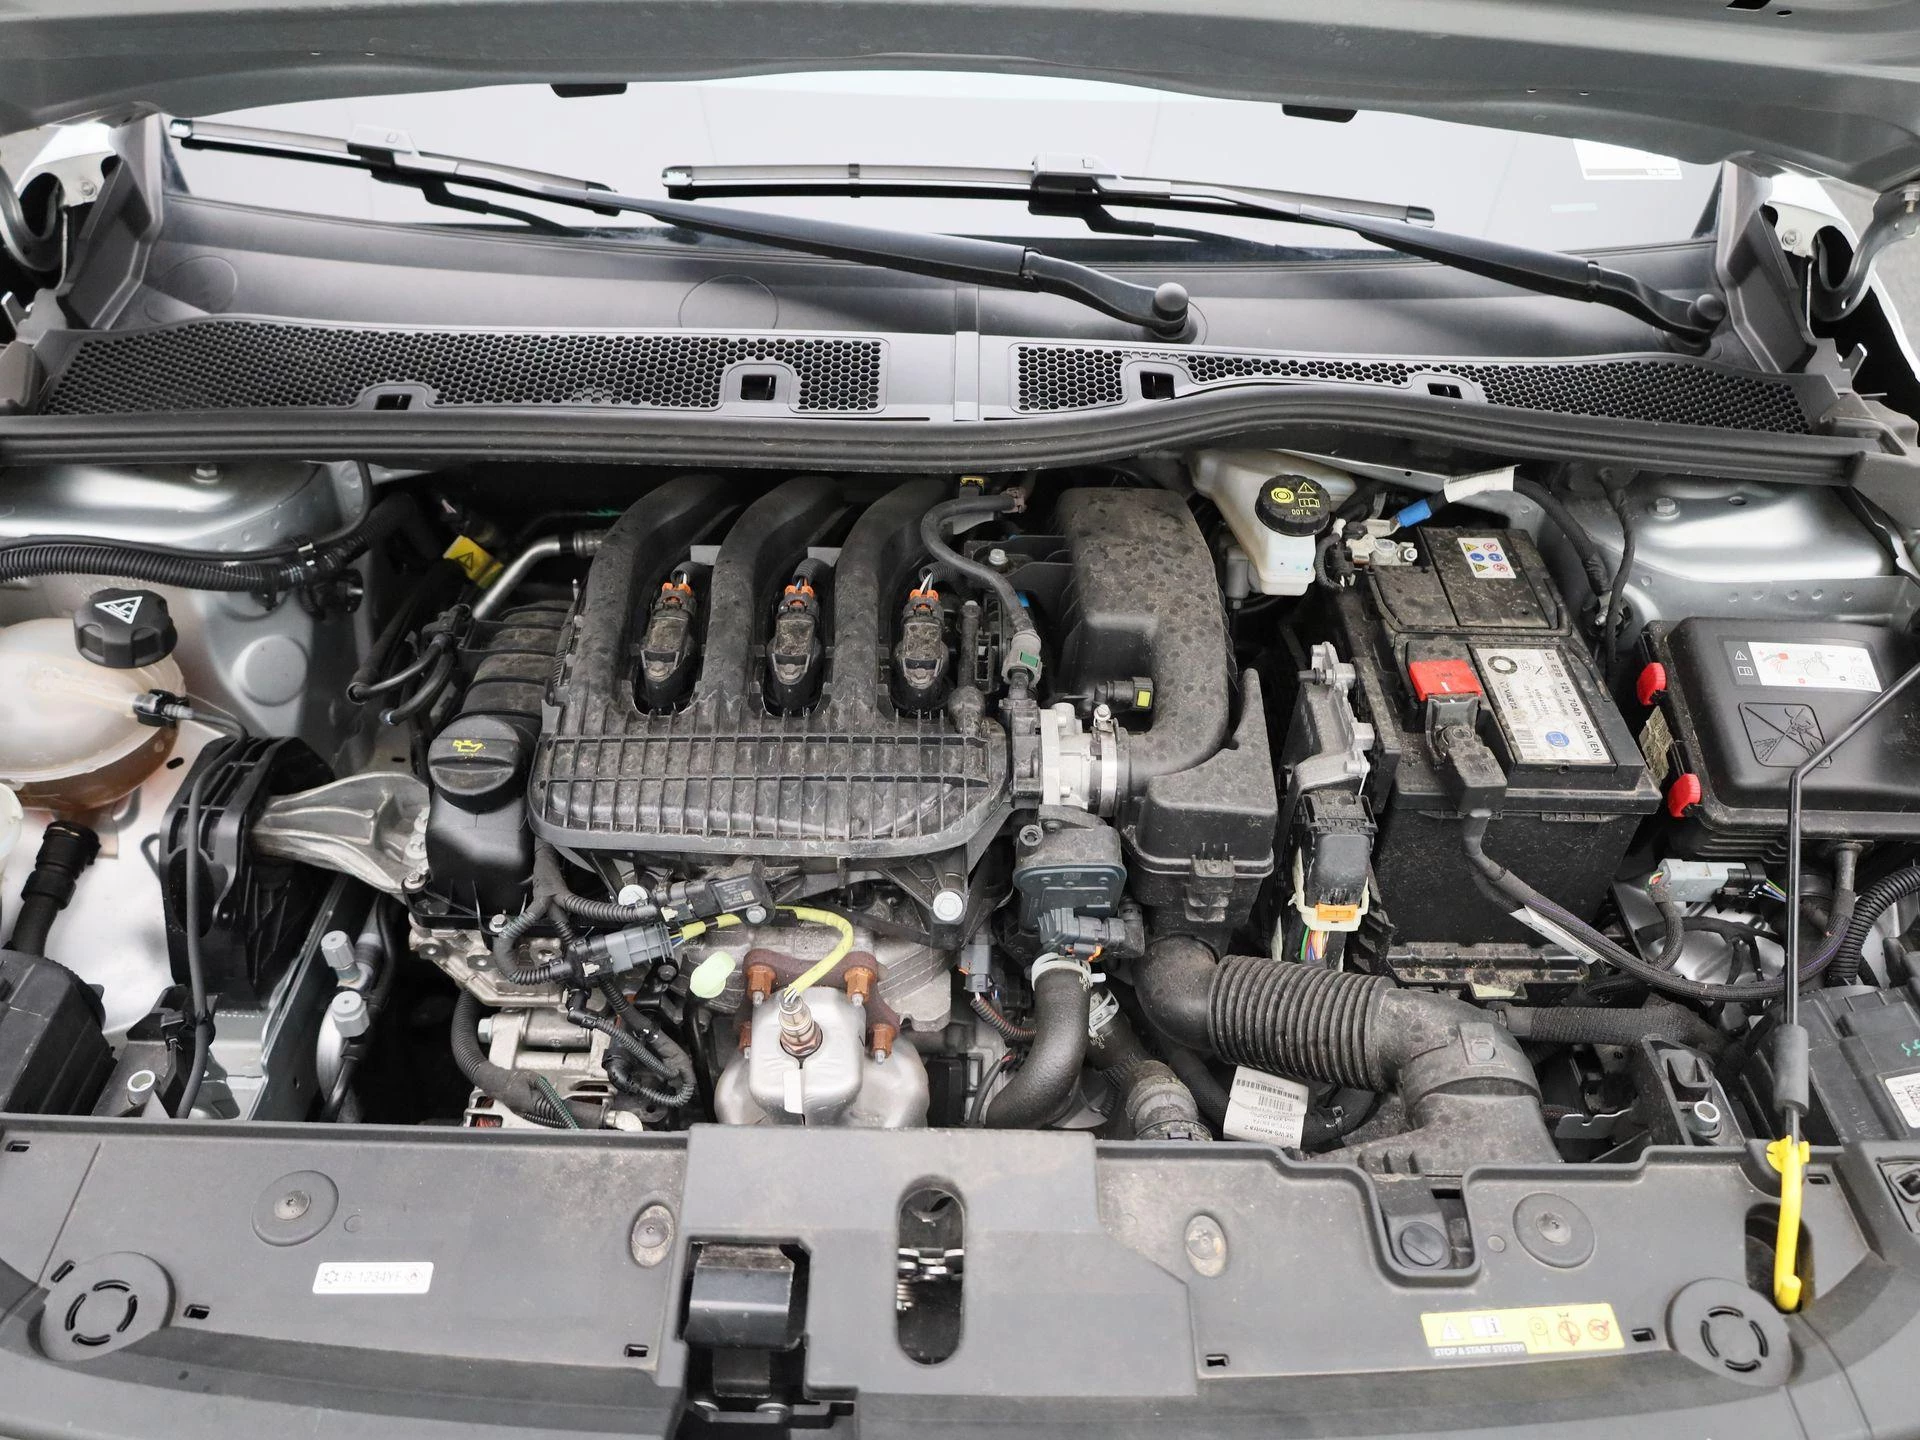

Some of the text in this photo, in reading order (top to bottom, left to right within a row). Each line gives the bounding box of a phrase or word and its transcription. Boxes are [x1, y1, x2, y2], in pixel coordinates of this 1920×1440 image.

[1504, 688, 1518, 711] VARTA
[1560, 681, 1572, 695] 12V
[1568, 698, 1581, 717] 70Ah
[1579, 720, 1594, 739] 760A
[1588, 739, 1603, 757] (EN)
[1434, 1343, 1526, 1356] STOP & START SYSTEM
